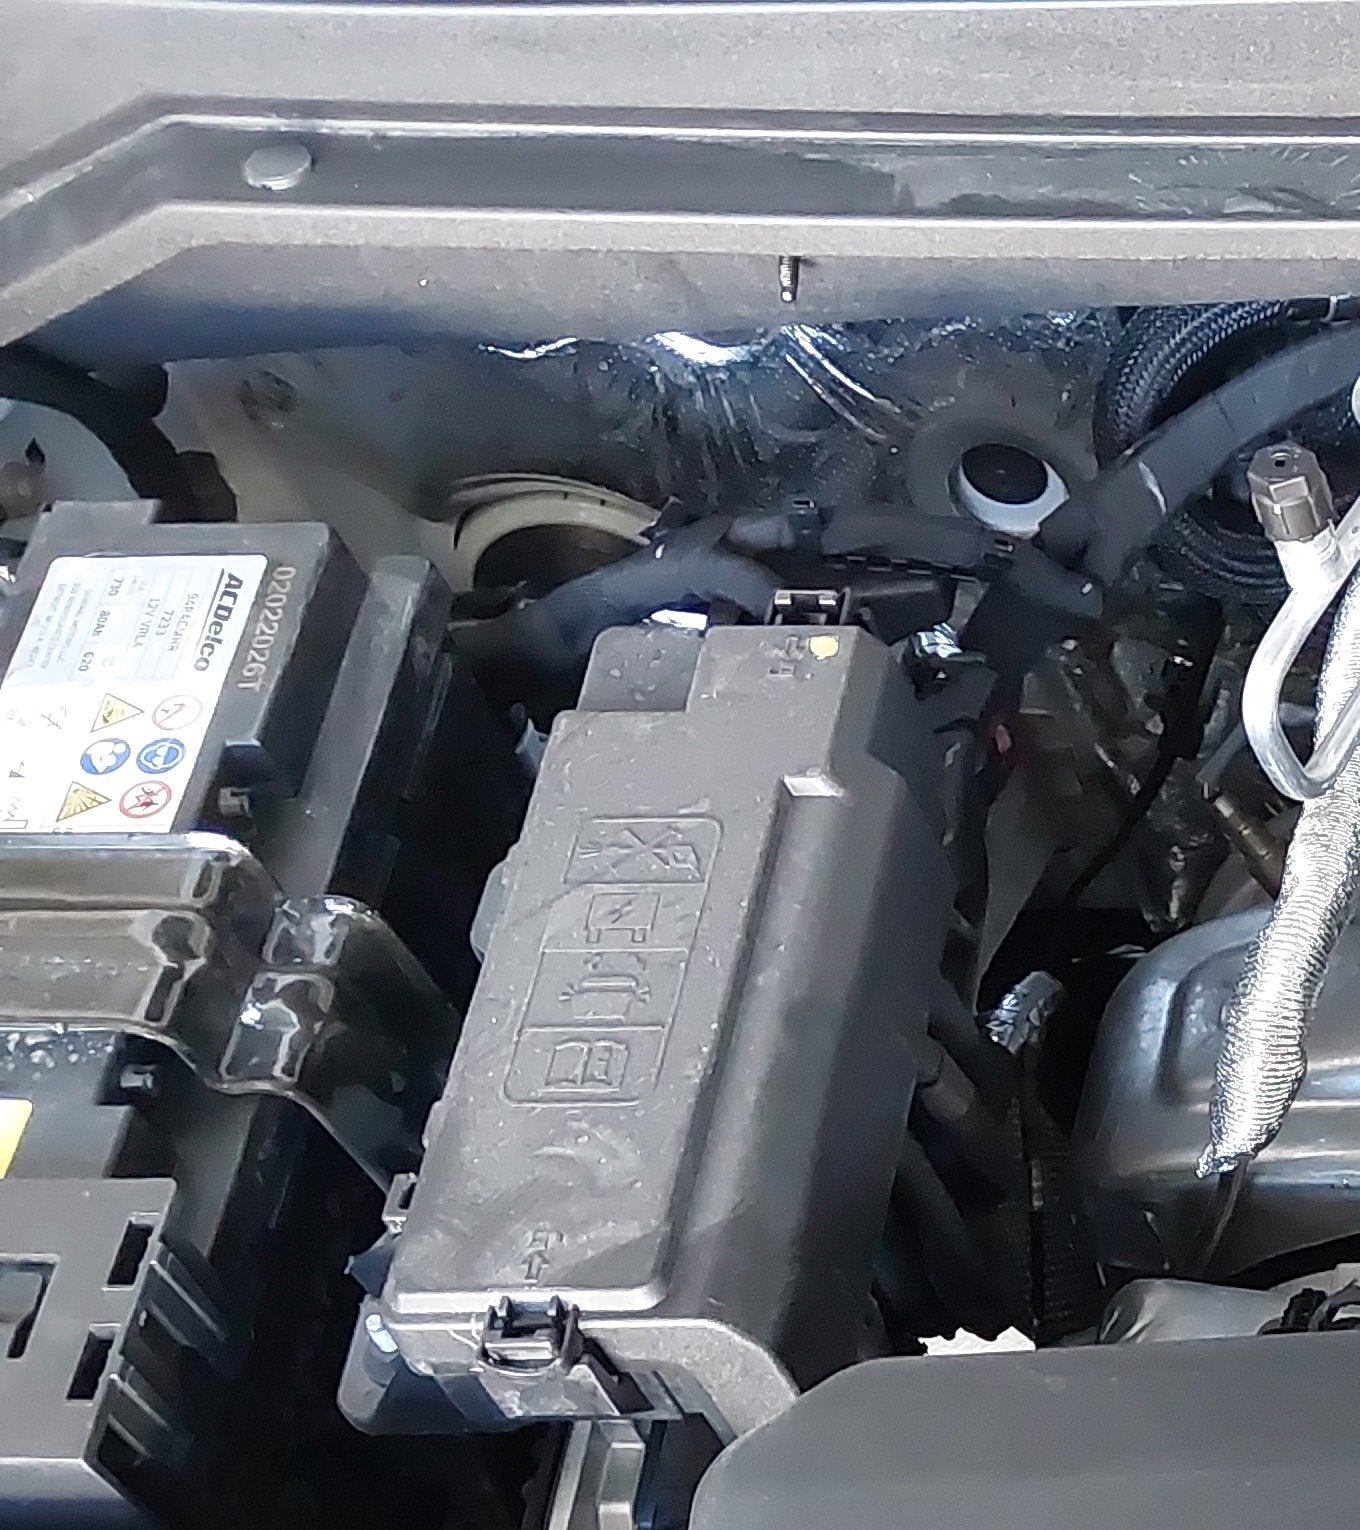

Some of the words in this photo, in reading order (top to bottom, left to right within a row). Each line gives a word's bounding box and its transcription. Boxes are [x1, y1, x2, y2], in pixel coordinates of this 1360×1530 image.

[78, 651, 94, 672] 620
[194, 572, 244, 672] ACDelco
[238, 565, 297, 692] 02022026T
